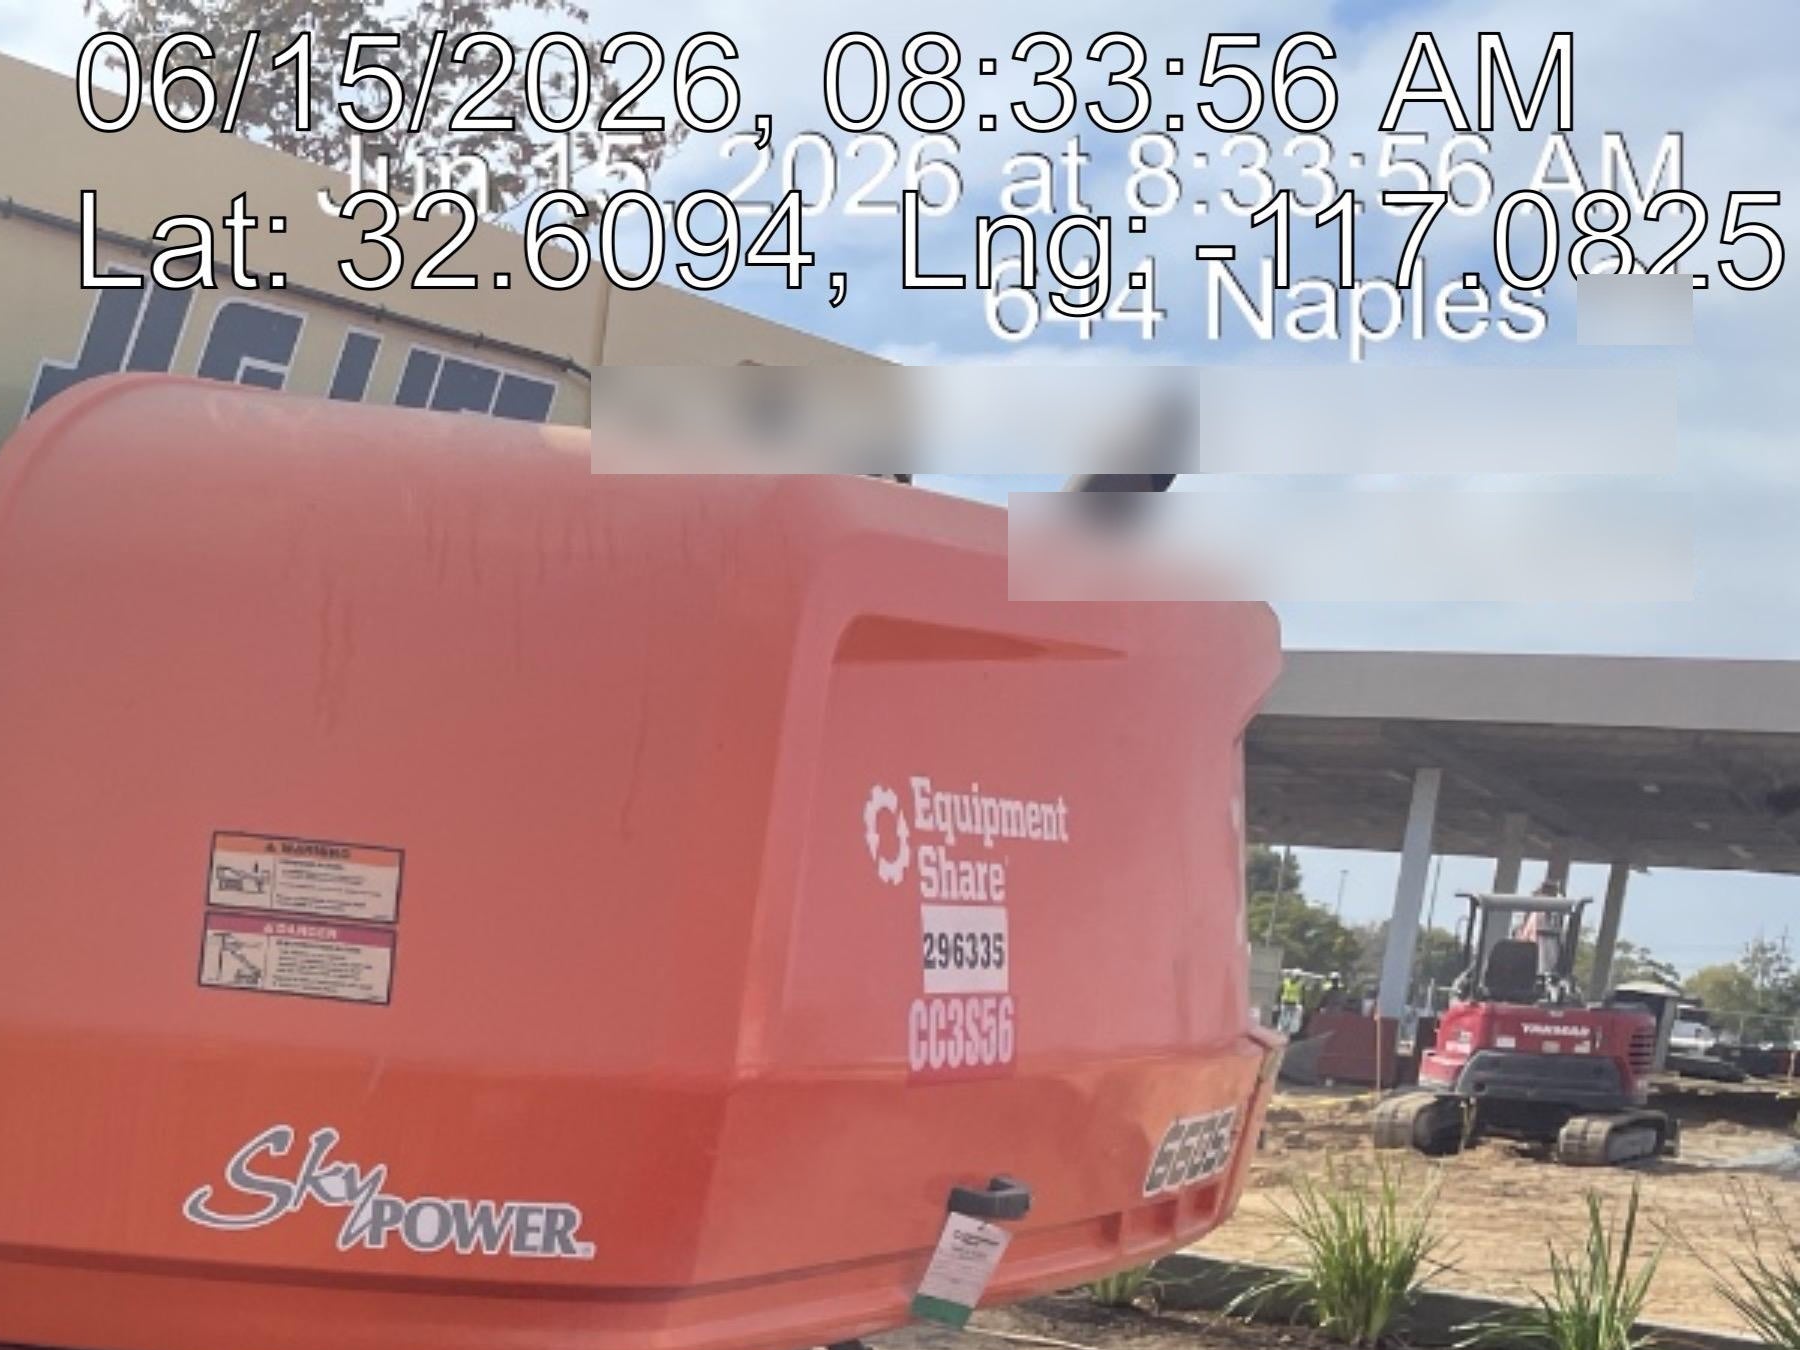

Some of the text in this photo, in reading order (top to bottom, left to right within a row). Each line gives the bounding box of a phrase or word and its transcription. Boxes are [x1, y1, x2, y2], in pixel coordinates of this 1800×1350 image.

[909, 775, 1069, 849] Equipment
[917, 844, 1007, 902] Share
[922, 932, 1005, 970] 296335
